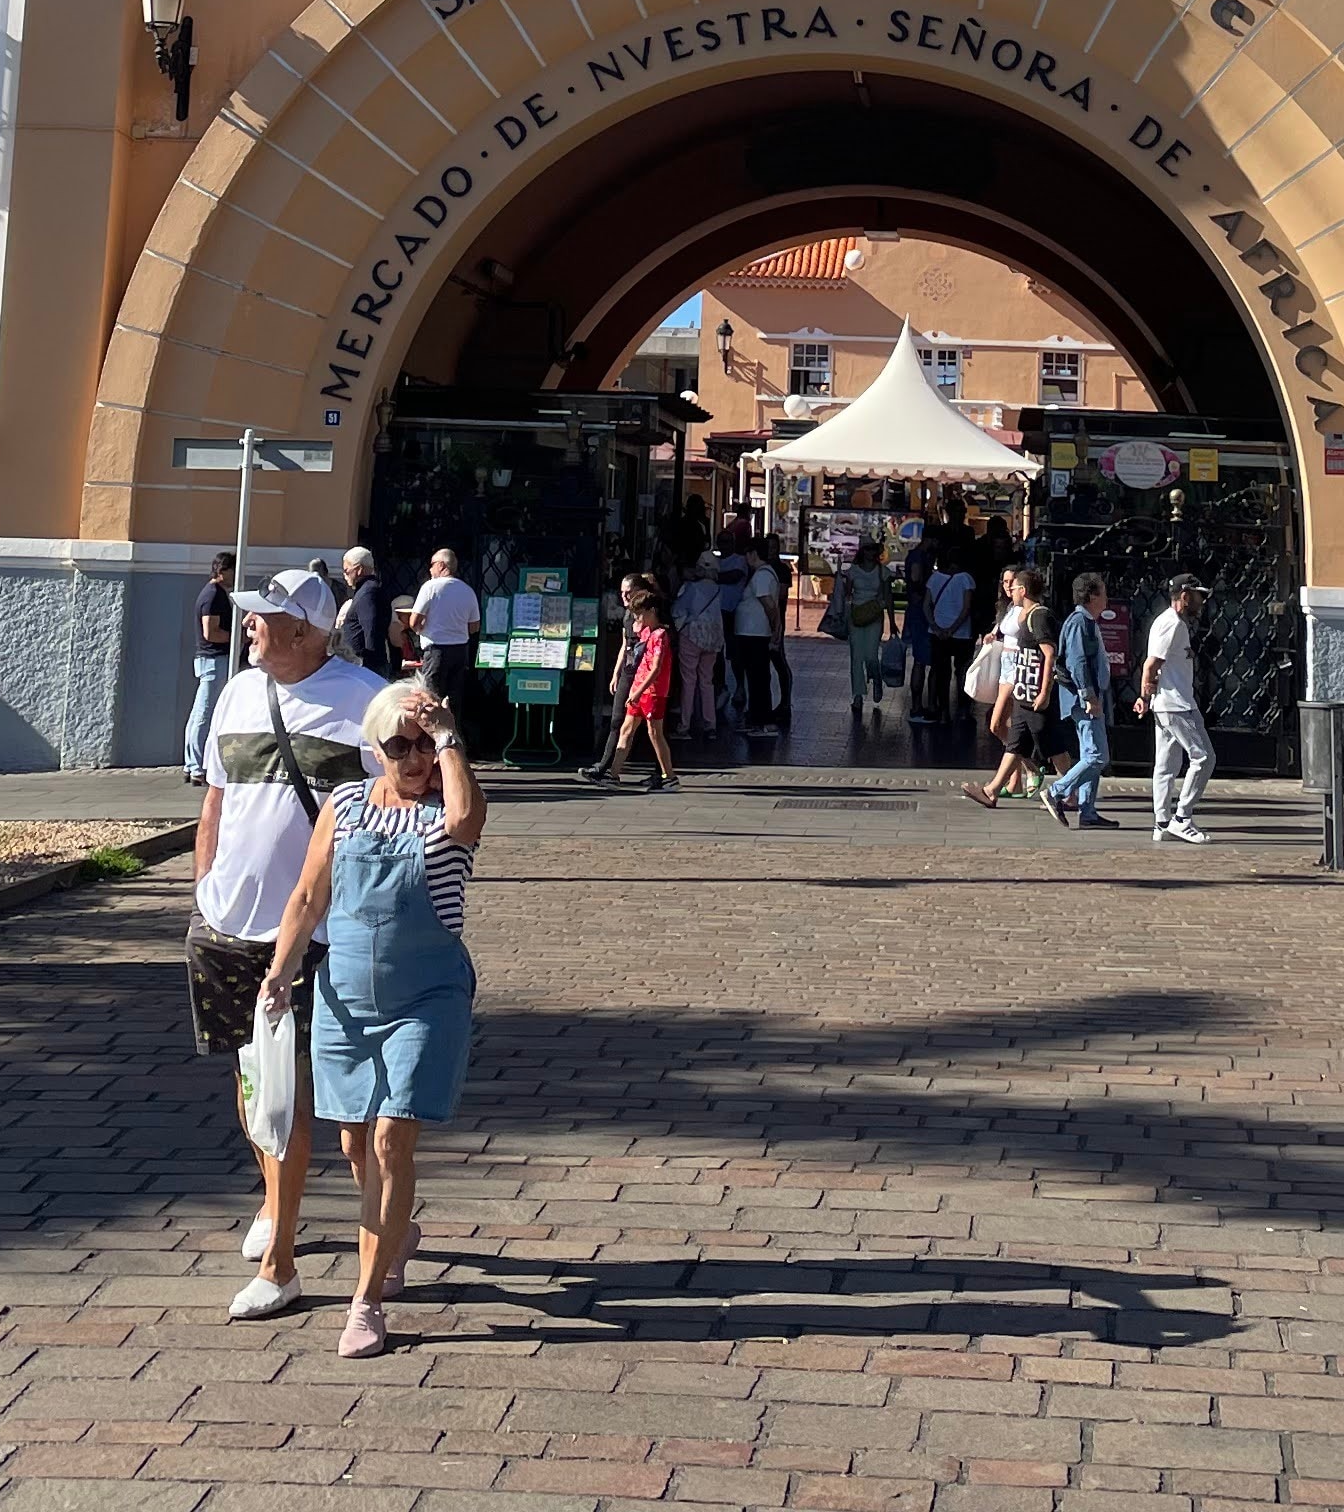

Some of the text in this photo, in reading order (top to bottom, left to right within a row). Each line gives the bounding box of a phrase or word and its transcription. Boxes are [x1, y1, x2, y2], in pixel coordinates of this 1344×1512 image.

[320, 165, 474, 402] MERCADO
[493, 92, 559, 151] DE
[887, 9, 1093, 113] SEÑORA
[1128, 115, 1192, 178] DE
